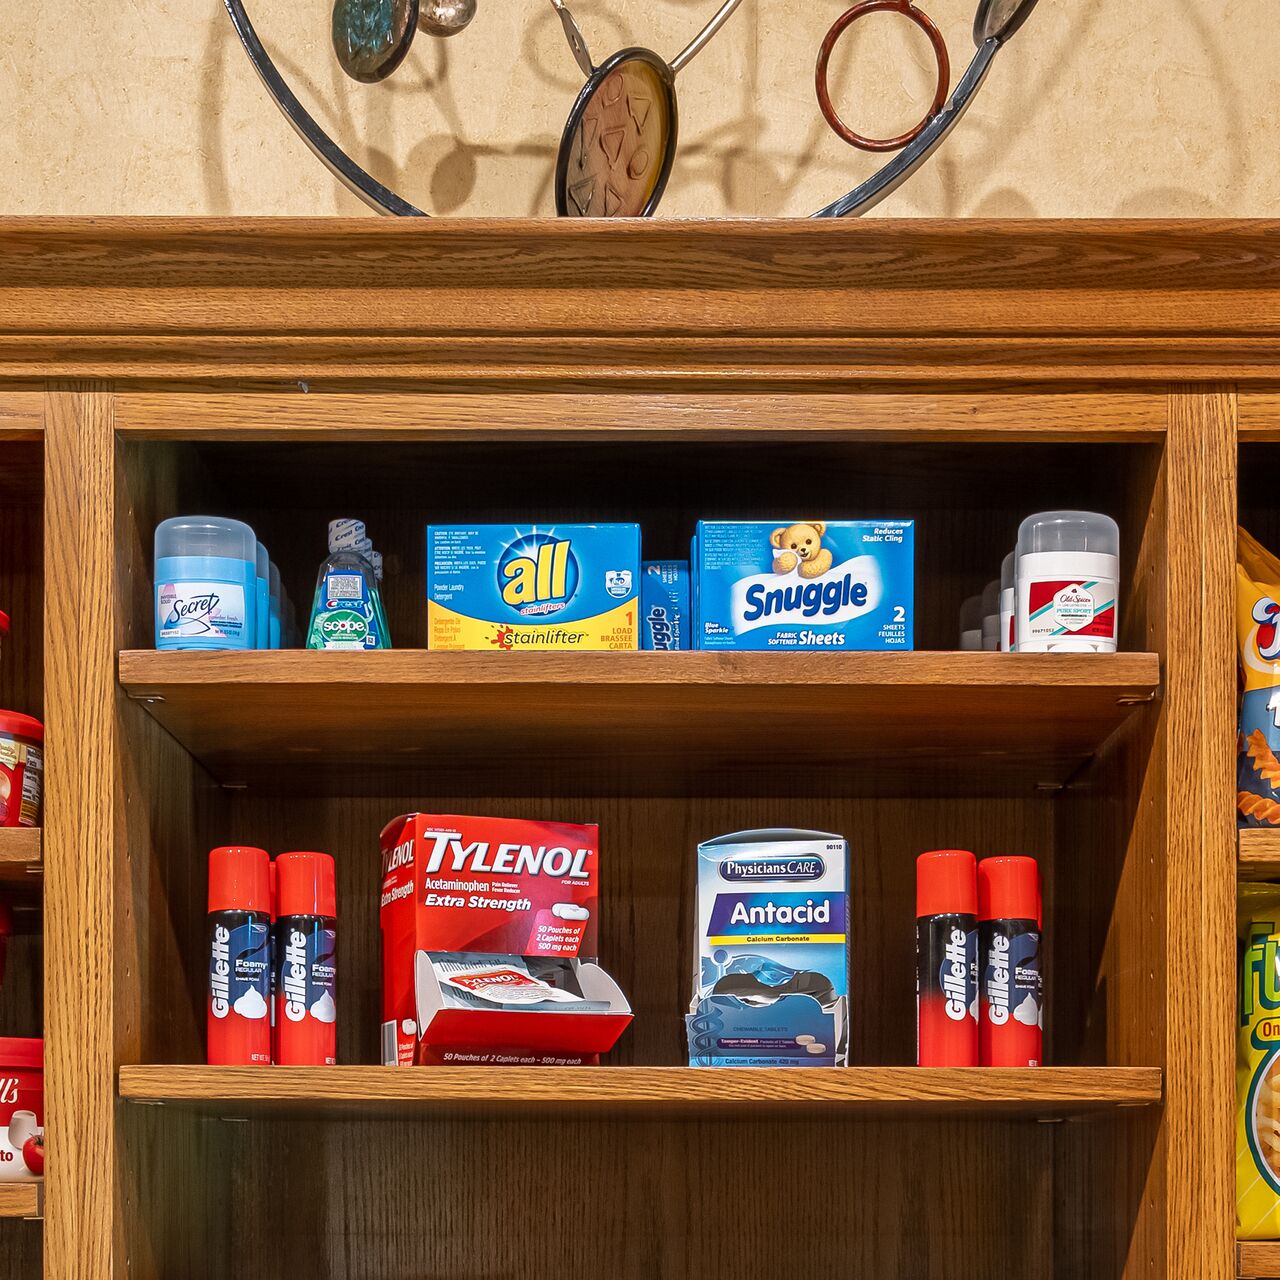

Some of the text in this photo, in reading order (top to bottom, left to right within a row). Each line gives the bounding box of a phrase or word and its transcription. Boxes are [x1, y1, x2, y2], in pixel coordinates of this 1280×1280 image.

[885, 535, 903, 543] Cling
[503, 541, 570, 605] all
[744, 574, 867, 621] Snuggle
[173, 593, 220, 623] Secret
[521, 603, 565, 615] stainlifters
[893, 607, 905, 622] 2
[324, 620, 364, 632] scope
[625, 612, 632, 625] 1
[504, 631, 585, 647] stainlifter
[799, 631, 845, 645] Sheets
[424, 832, 590, 878] TYLENOL
[425, 878, 489, 892] Acetaminophen
[425, 895, 531, 911] Extra Strength
[730, 900, 830, 924] Antacid
[548, 927, 572, 935] Pouches
[542, 935, 563, 944] Caplets
[212, 926, 230, 1018] Gillette
[235, 960, 266, 970] Foamy
[285, 931, 306, 1022] Gillette
[944, 929, 966, 1020] Gillette
[988, 936, 1010, 1025] Gillette
